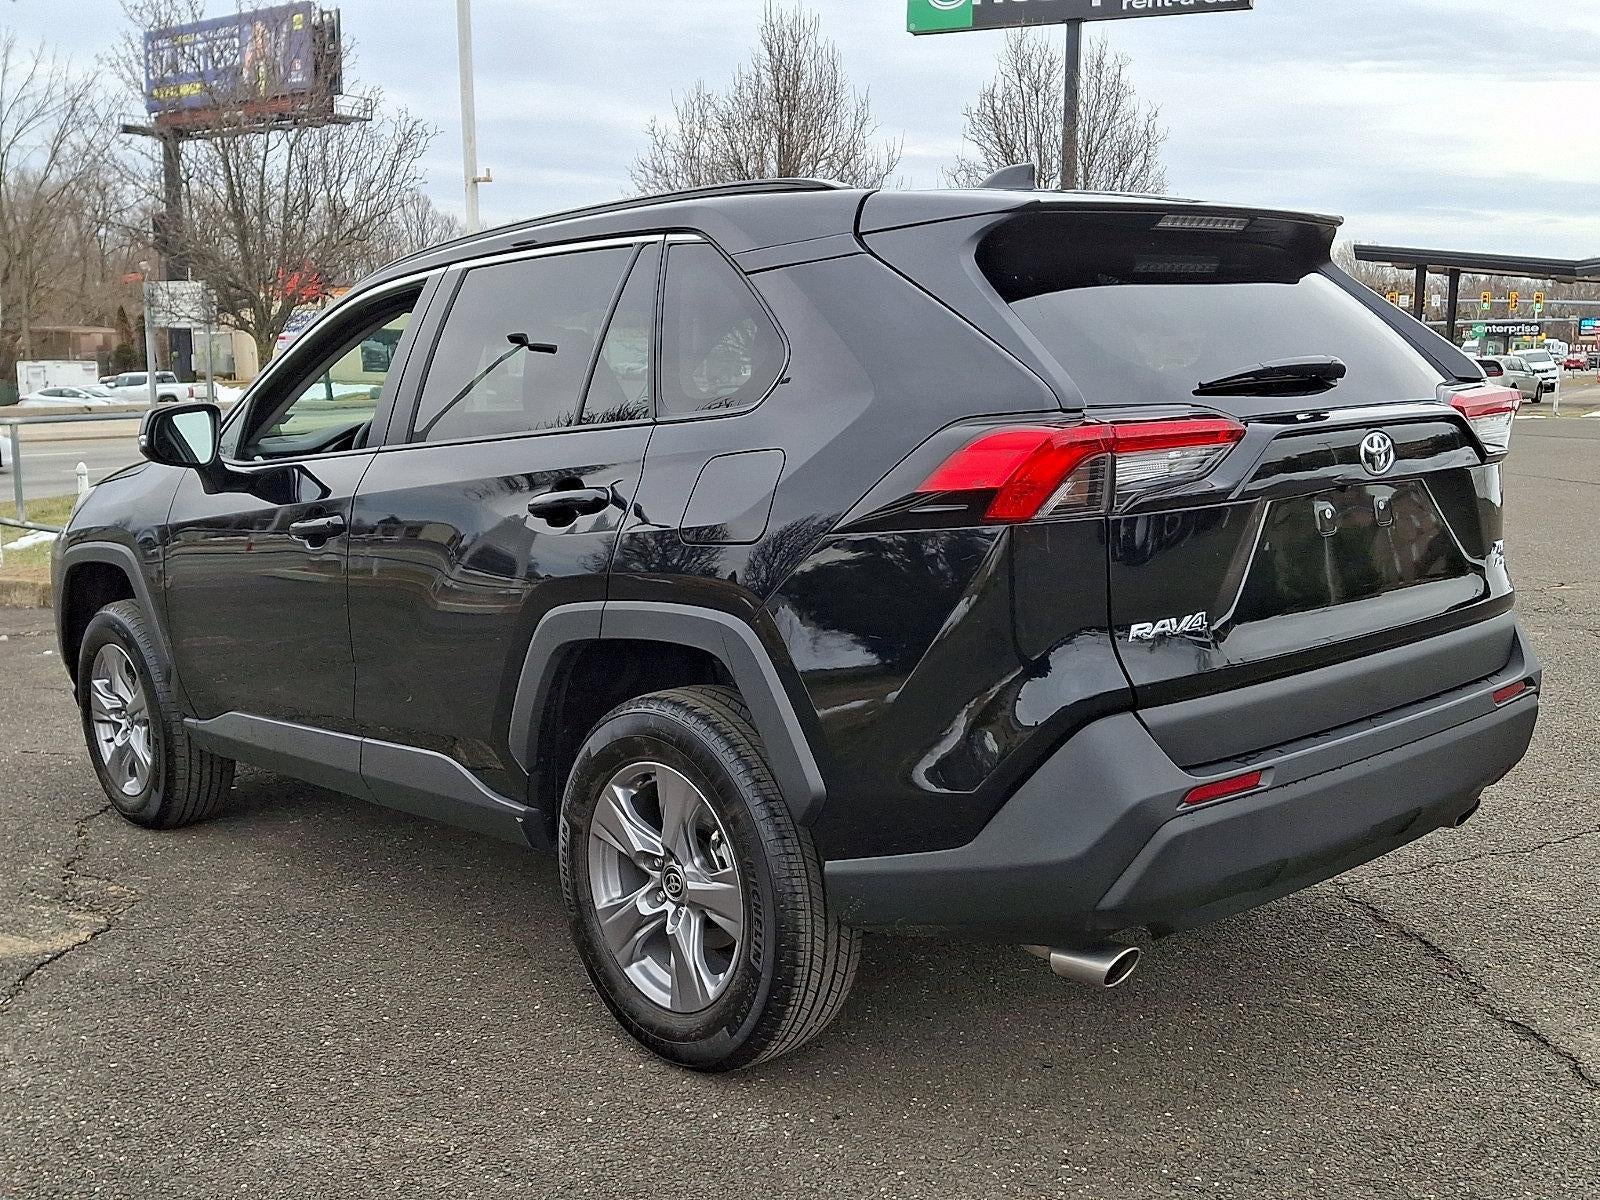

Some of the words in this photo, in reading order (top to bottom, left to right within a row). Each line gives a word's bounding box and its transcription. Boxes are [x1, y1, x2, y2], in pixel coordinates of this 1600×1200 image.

[1472, 324, 1540, 335] enterprise
[1128, 611, 1208, 642] RAV4
[744, 857, 764, 964] MICHELIN
